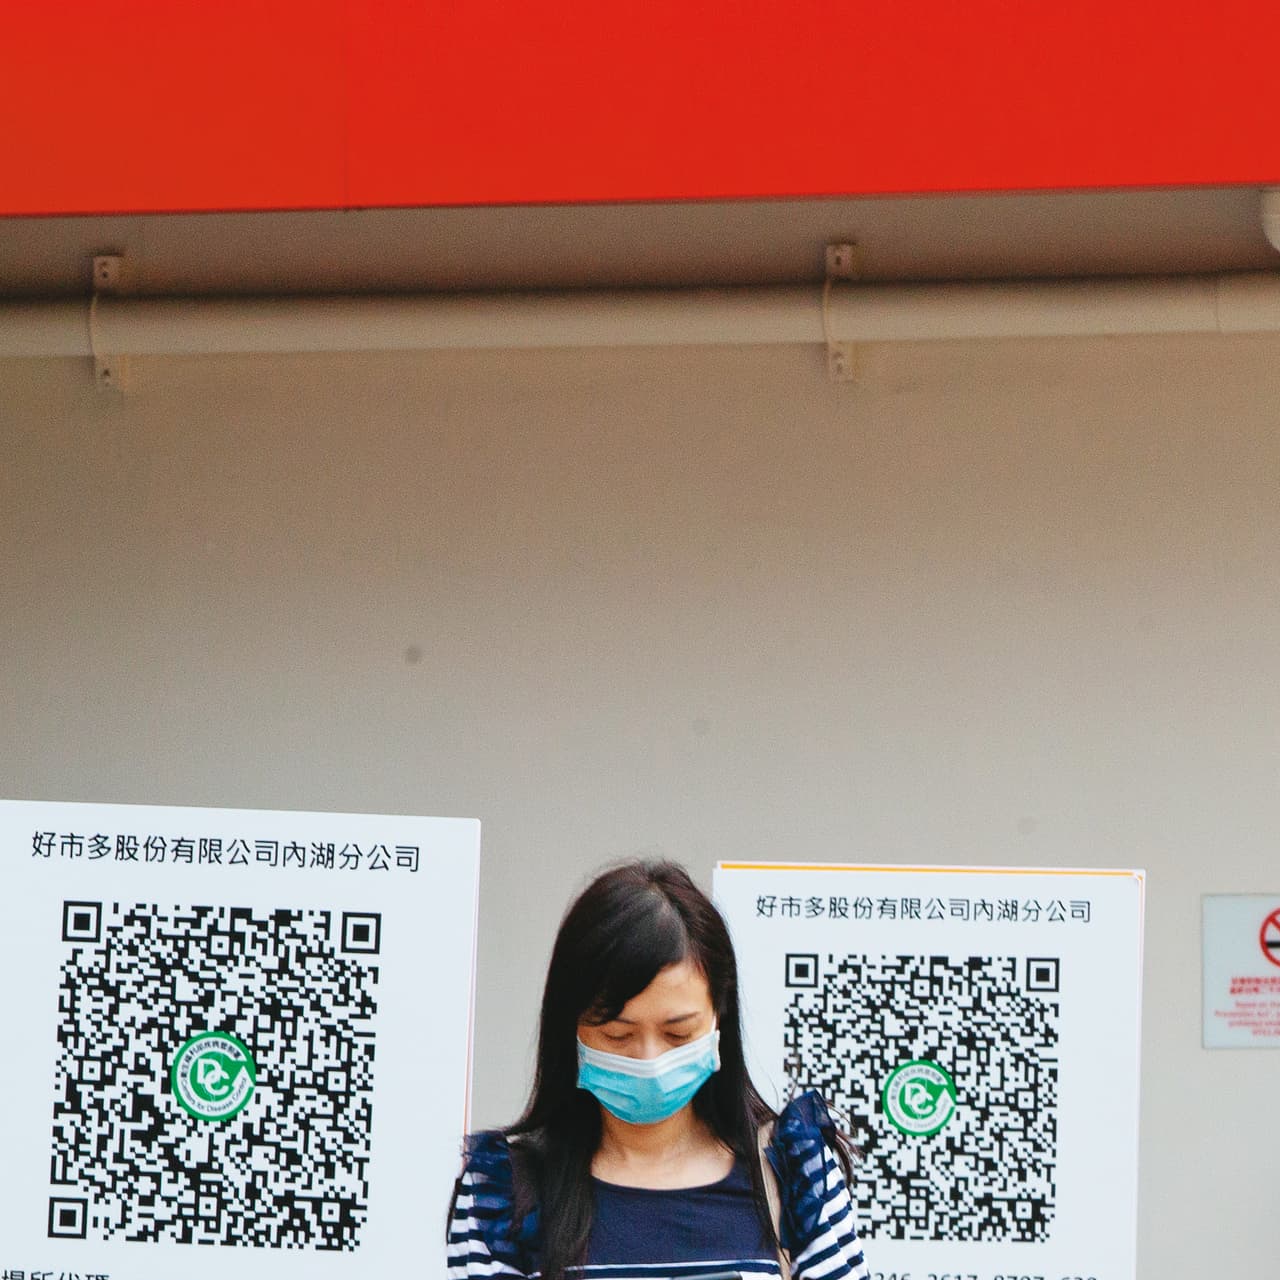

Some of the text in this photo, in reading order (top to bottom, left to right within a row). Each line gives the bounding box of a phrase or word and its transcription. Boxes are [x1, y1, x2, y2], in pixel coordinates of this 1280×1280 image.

[31, 831, 420, 873] 好市多股份有限公司內湖分公司
